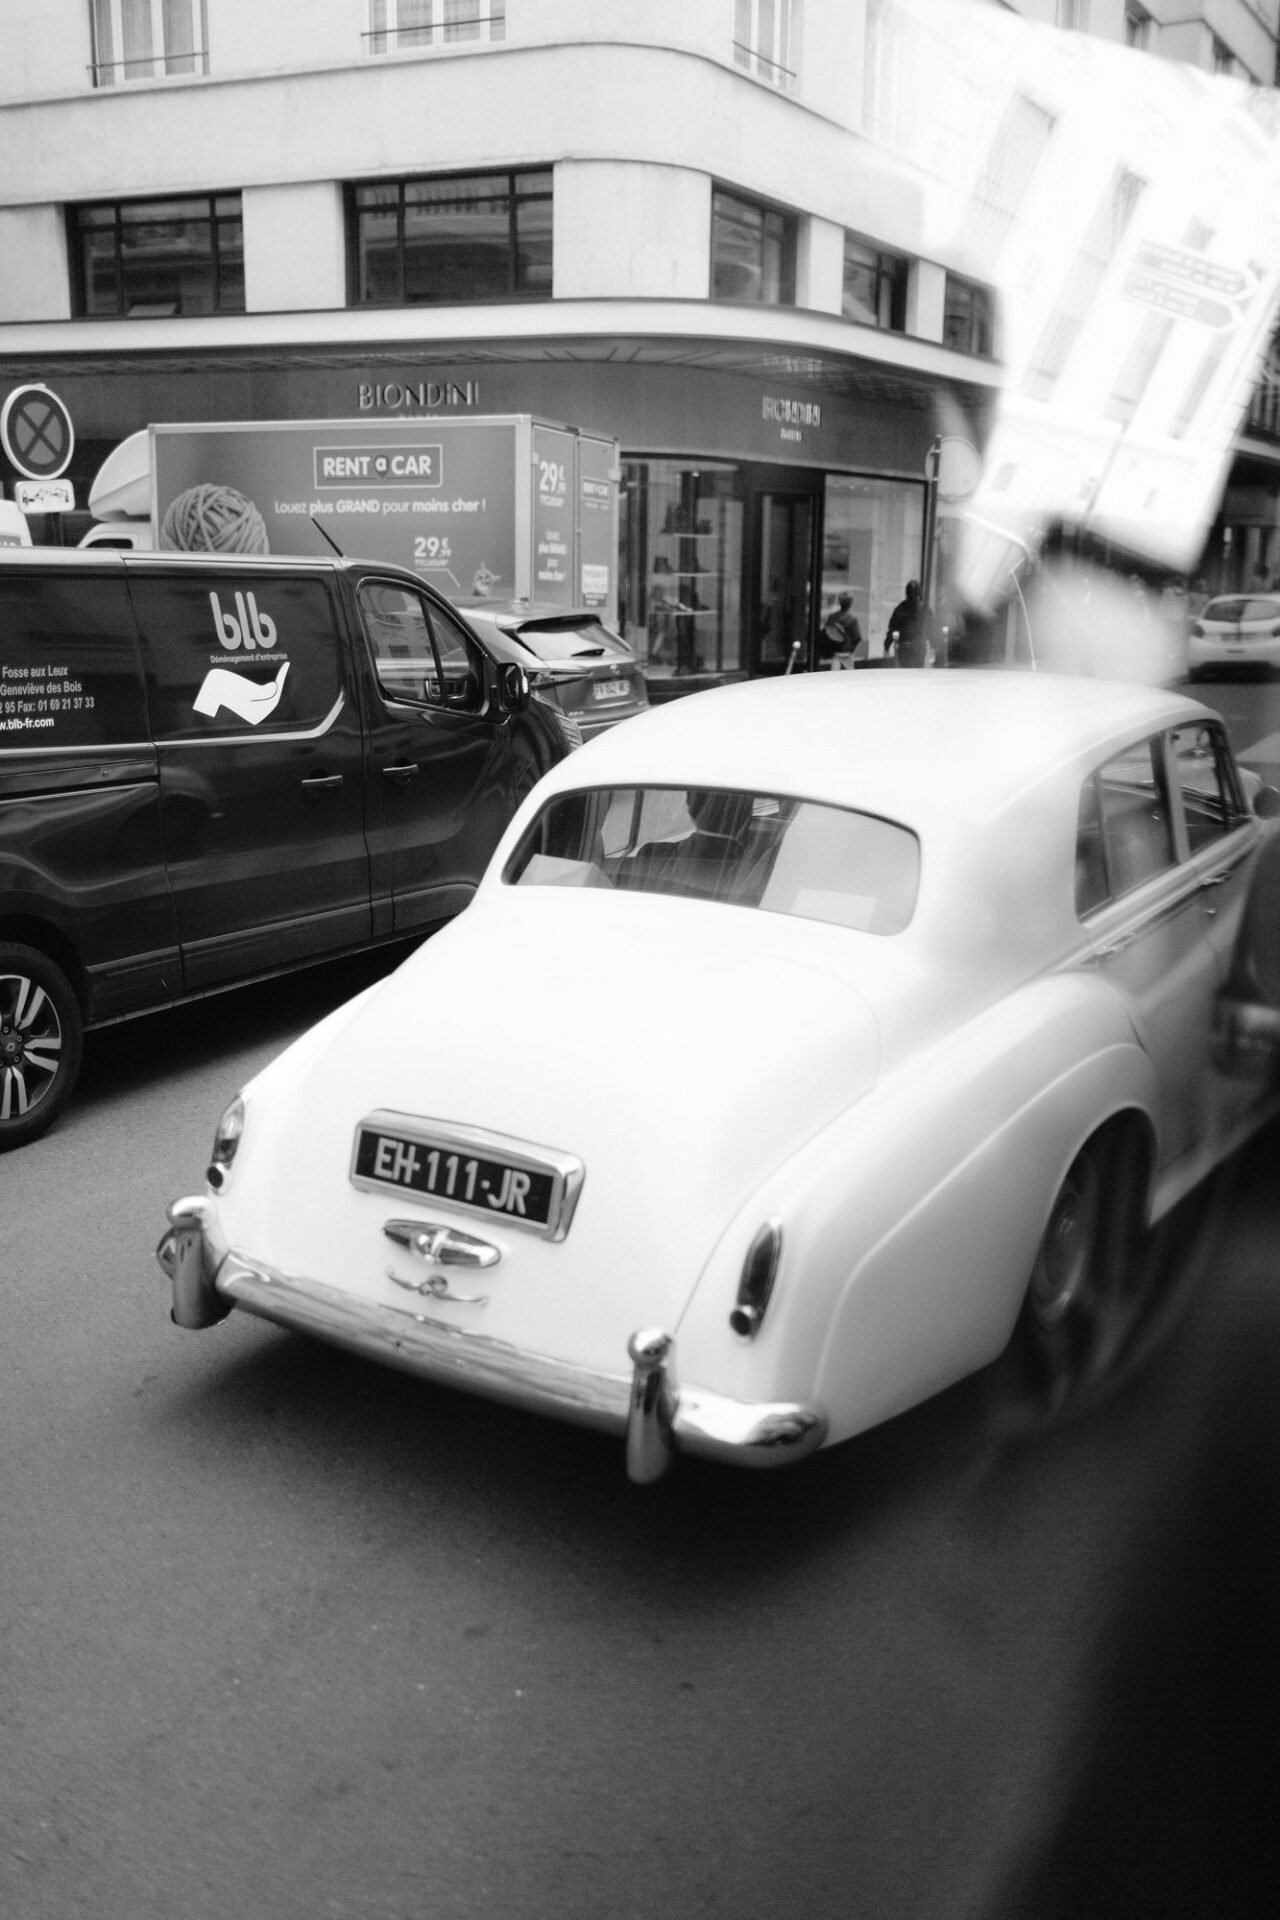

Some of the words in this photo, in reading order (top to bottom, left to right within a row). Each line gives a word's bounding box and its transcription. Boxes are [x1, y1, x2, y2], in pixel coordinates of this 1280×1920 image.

[358, 381, 479, 410] BIONDINI
[323, 456, 371, 477] RENT
[375, 457, 387, 472] a
[391, 455, 432, 475] CAR
[274, 500, 307, 514] Louez
[309, 499, 334, 518] plus
[336, 499, 380, 513] GRAND
[382, 501, 409, 517] pour
[412, 498, 449, 513] moins
[451, 498, 479, 513] cher
[209, 591, 278, 651] blb
[2, 666, 29, 679] Fosse
[30, 668, 46, 678] aux
[48, 665, 68, 677] Leux
[0, 682, 45, 696] Geneviève
[47, 681, 62, 694] des
[64, 680, 82, 693] Bois
[5, 701, 16, 714] 95
[17, 700, 36, 713] Fax:
[38, 699, 47, 711] 01
[50, 699, 60, 711] 69
[62, 698, 71, 710] 21
[73, 697, 83, 709] 37
[85, 696, 95, 708] 33
